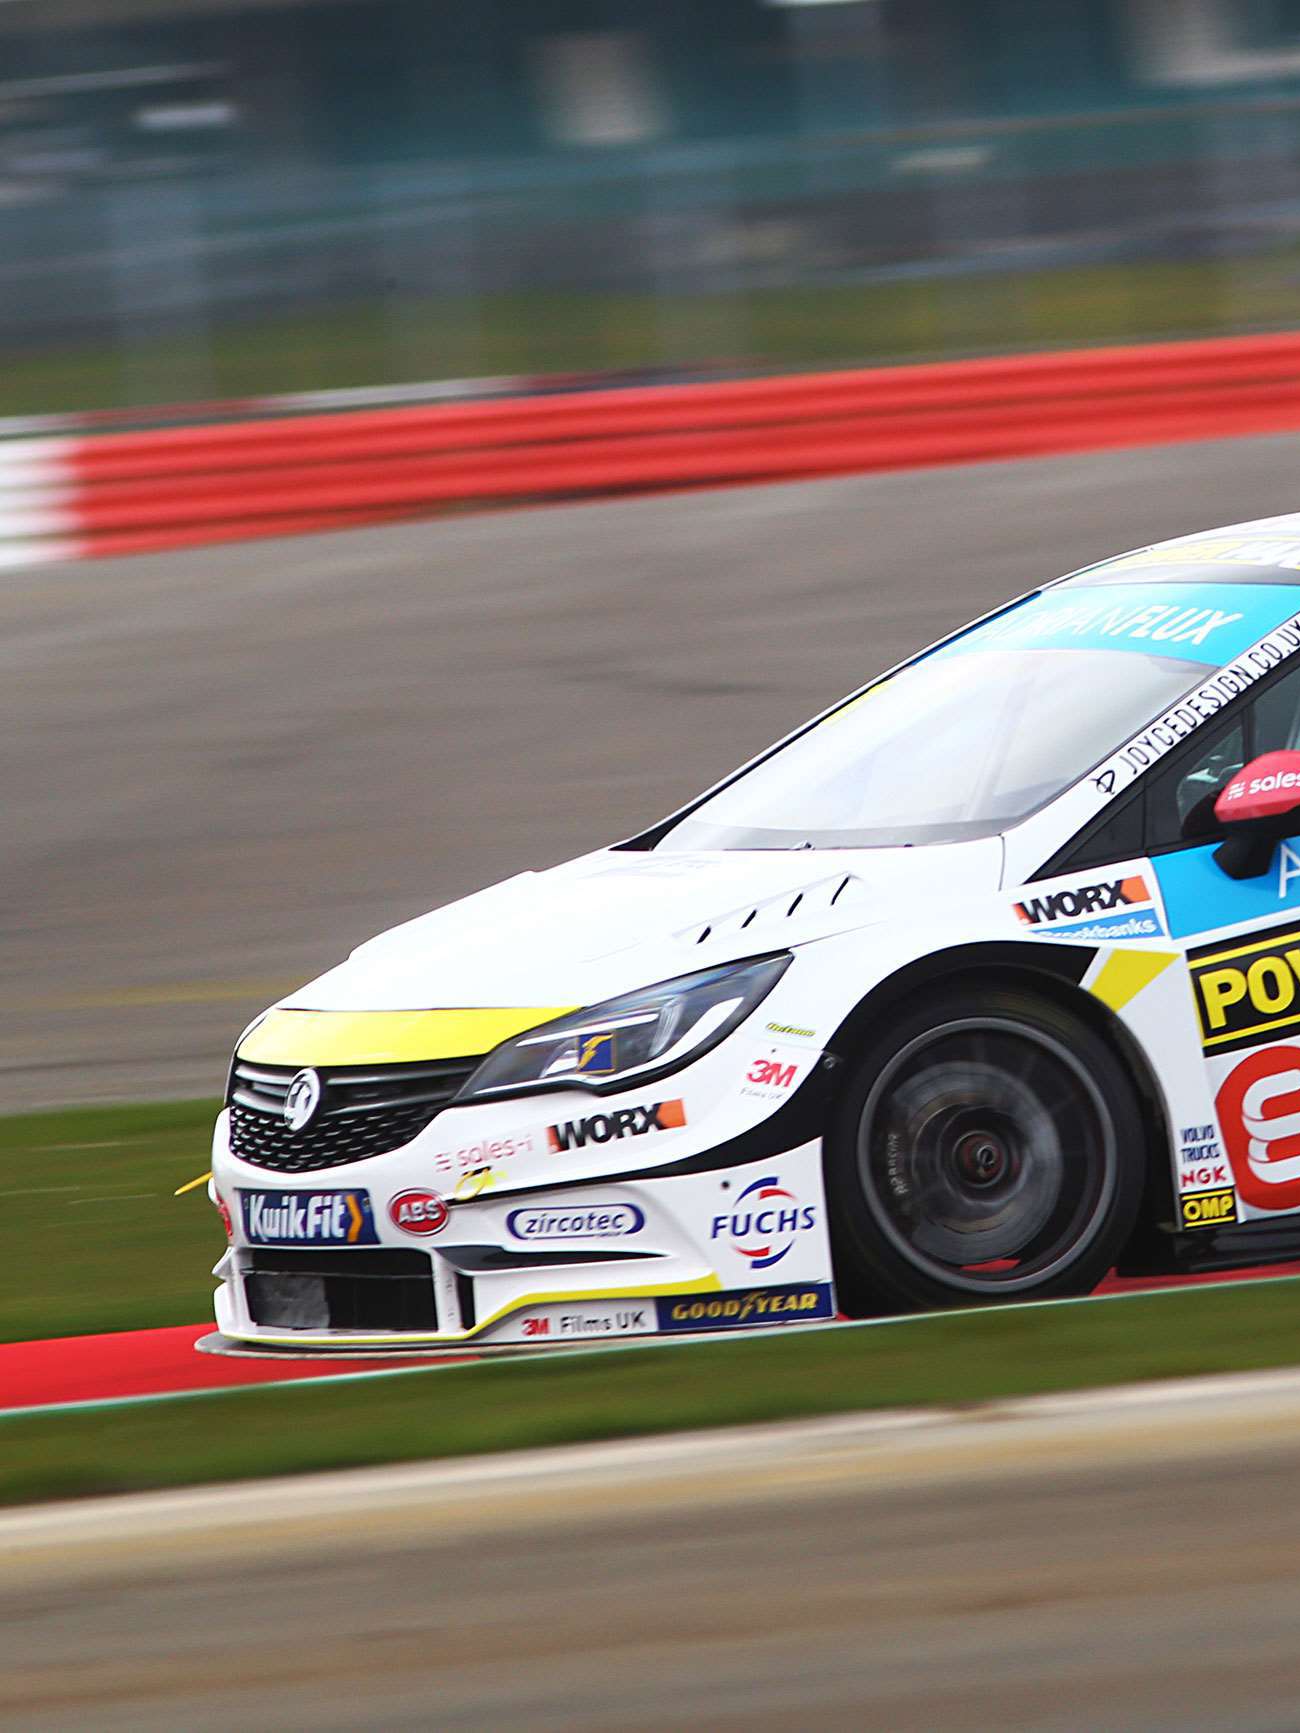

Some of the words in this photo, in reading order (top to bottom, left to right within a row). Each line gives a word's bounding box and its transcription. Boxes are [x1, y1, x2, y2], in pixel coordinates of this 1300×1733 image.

[1018, 879, 1134, 924] WORX
[746, 1060, 799, 1088] 3M
[554, 1101, 669, 1152] WORX
[1181, 1124, 1216, 1144] VOLVO
[1181, 1166, 1228, 1188] NGK
[399, 1201, 441, 1225] ABS
[1183, 1196, 1235, 1222] OMP
[525, 1213, 625, 1234] zircotec
[711, 1206, 816, 1240] FUCHS
[521, 1317, 551, 1337] 3M
[560, 1314, 610, 1334] Films
[616, 1310, 646, 1331] UK
